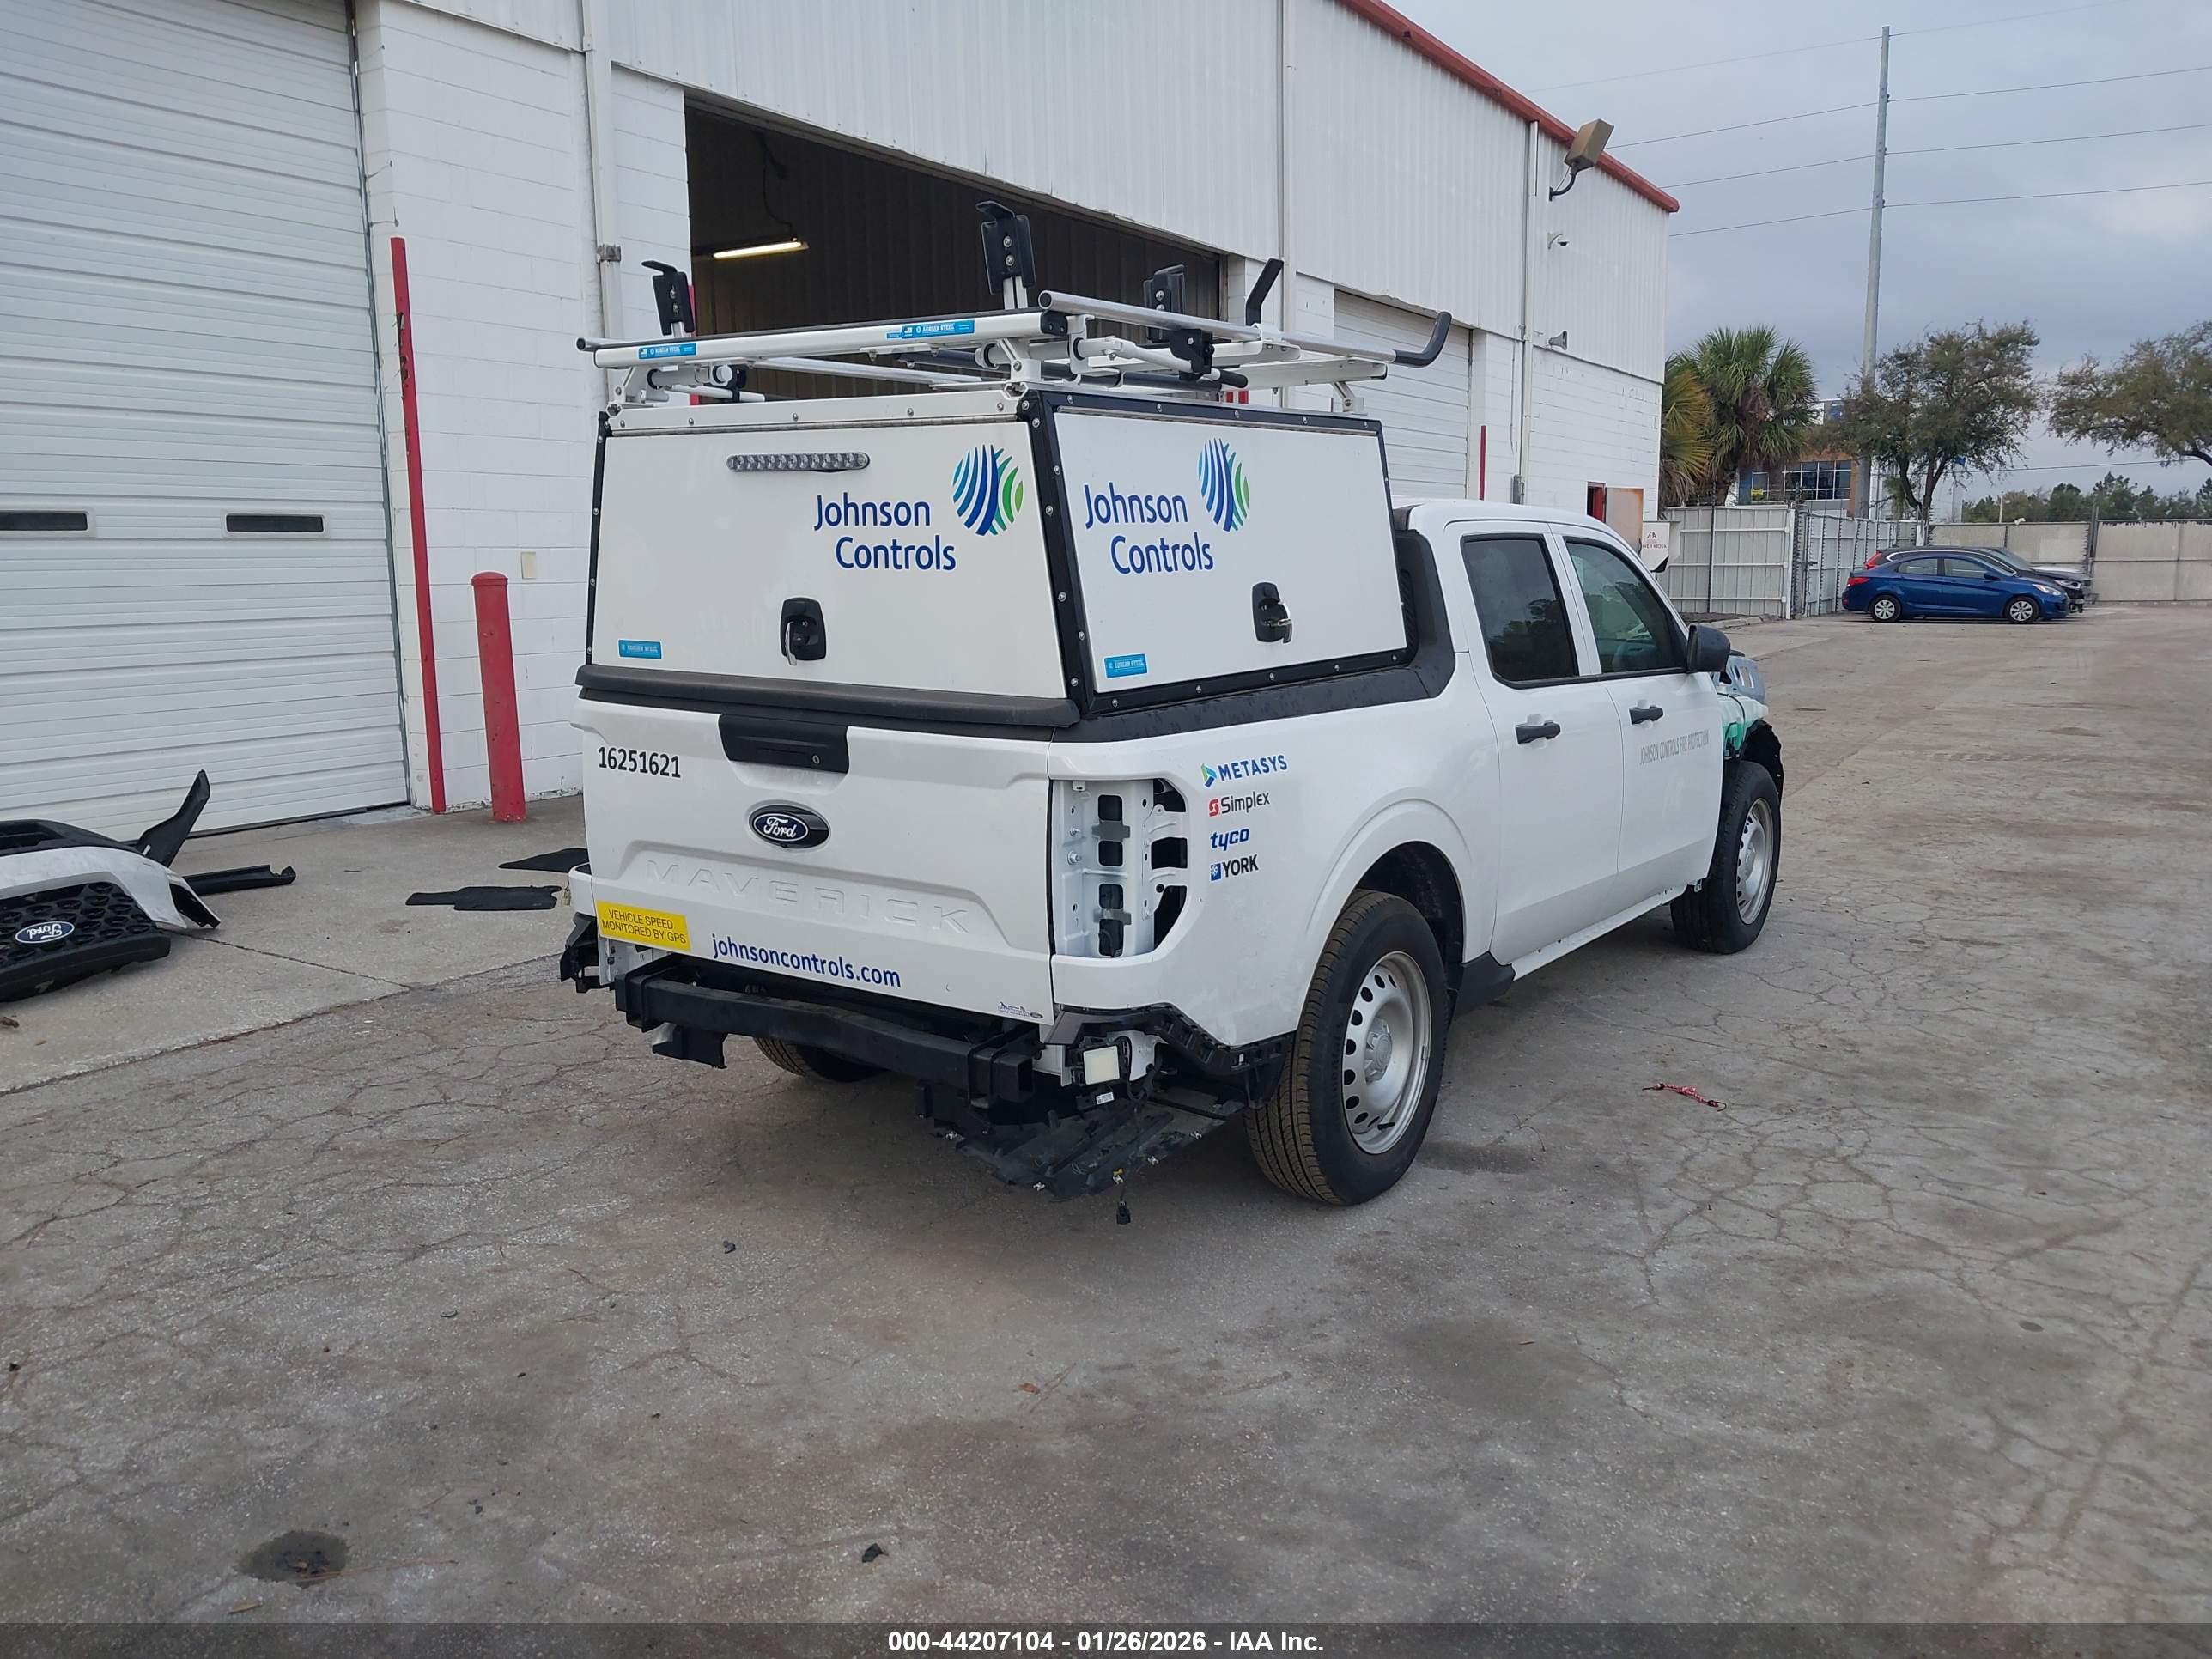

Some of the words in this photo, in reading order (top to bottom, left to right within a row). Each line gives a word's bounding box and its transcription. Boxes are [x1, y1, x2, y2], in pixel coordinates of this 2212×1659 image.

[814, 491, 931, 531] Johnson
[1084, 481, 1188, 529] Johnson
[836, 534, 957, 571] Controls
[1110, 531, 1214, 574] Controls
[598, 746, 681, 778] 16251621
[1218, 754, 1288, 782] METASYS
[1220, 790, 1271, 814] Simplex
[763, 816, 799, 838] Ford
[1210, 828, 1250, 852] tyco
[1222, 854, 1260, 878] YORK
[647, 860, 969, 936] MAVERICK
[26, 923, 63, 940] Ford
[601, 919, 652, 938] MONITORED
[653, 928, 665, 940] BY
[666, 931, 687, 945] GPS
[608, 908, 644, 925] VEHICLE
[644, 915, 674, 930] SPEED
[711, 933, 902, 989] johnsoncontrols.com
